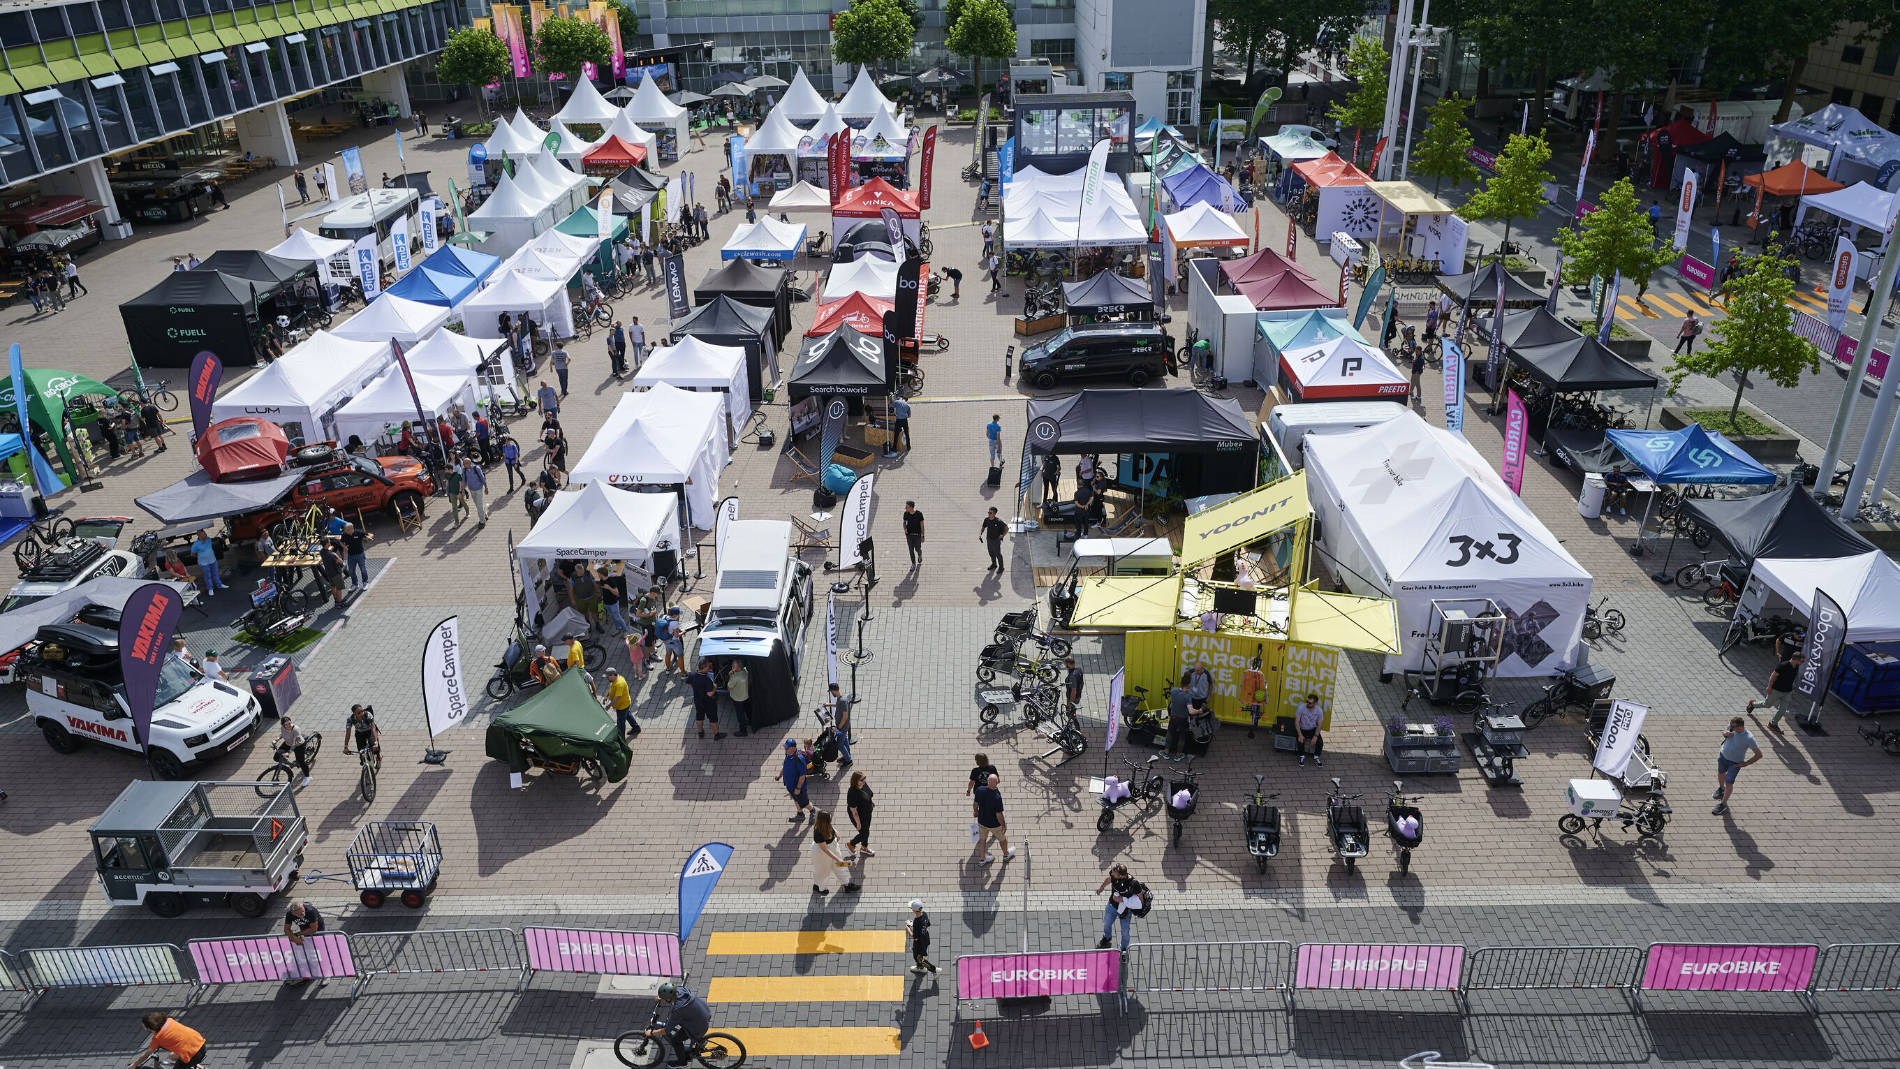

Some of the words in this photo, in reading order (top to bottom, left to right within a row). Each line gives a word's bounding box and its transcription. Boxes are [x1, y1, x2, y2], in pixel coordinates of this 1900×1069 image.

[362, 263, 375, 290] dimb
[1686, 264, 1708, 279] EUROBIKE
[899, 275, 918, 289] bo
[884, 325, 895, 343] bo
[810, 385, 836, 394] Search
[836, 386, 868, 394] bo.world
[1377, 385, 1406, 394] PREETO
[1216, 440, 1243, 448] Mubea
[1199, 495, 1295, 540] YOONIT
[556, 548, 608, 557] SpaceCamper
[131, 591, 169, 662] YAKIMA
[1182, 634, 1231, 653] MINI
[441, 625, 466, 720] SpaceCamper
[67, 715, 128, 742] YAKIMA
[1605, 704, 1625, 751] YOONIT
[1621, 708, 1634, 731] PRO
[991, 968, 1088, 983] EUROBIKE
[1680, 961, 1782, 975] EUROBIKE
